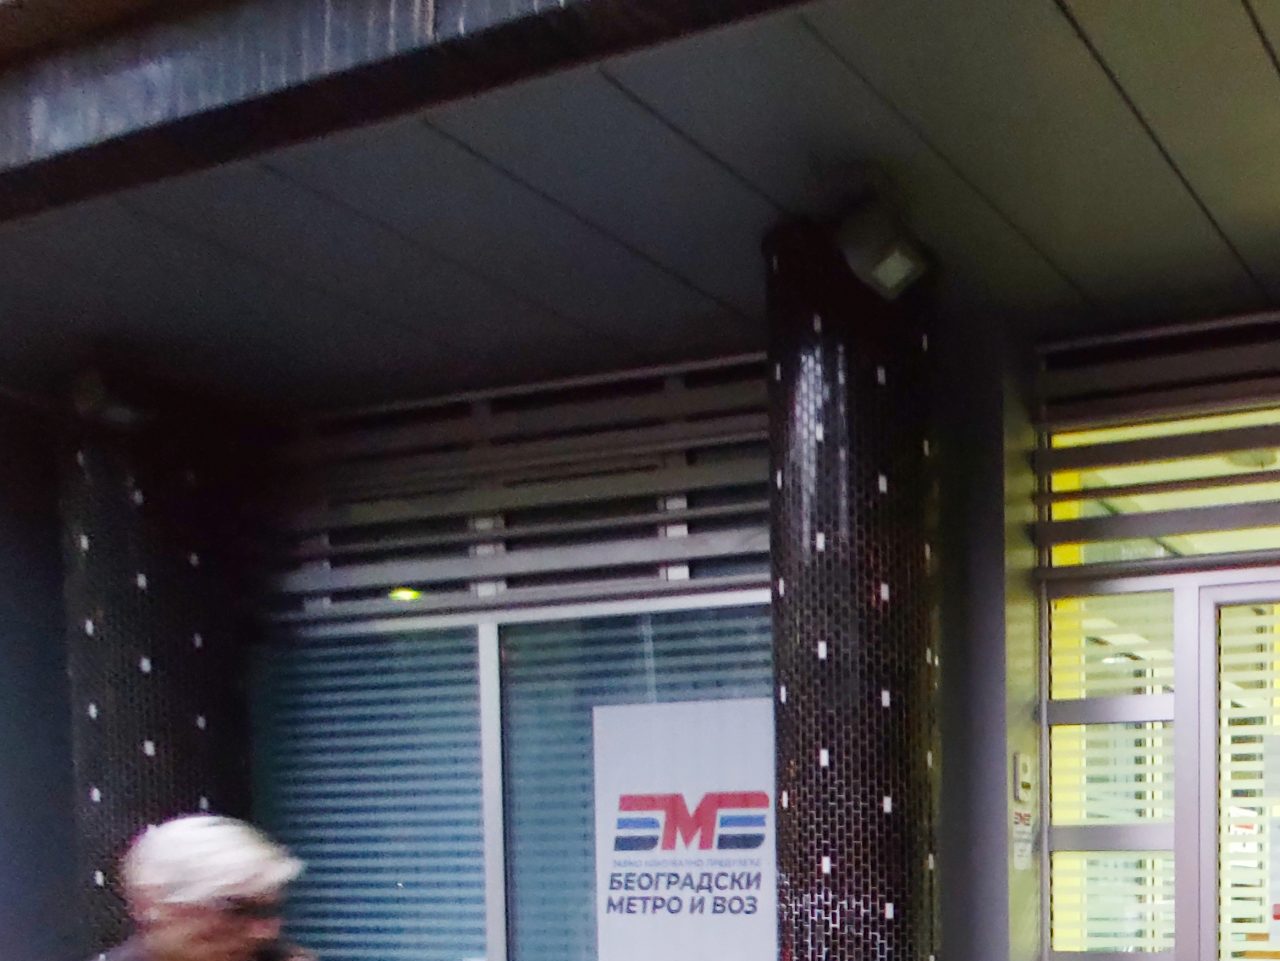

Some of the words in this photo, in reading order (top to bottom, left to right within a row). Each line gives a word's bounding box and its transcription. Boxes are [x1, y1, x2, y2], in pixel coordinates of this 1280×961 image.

[608, 871, 762, 894] БЕОГРАДСКИ
[606, 895, 683, 915] МЕТРО
[689, 895, 705, 915] И
[712, 895, 759, 915] ВОЗ
